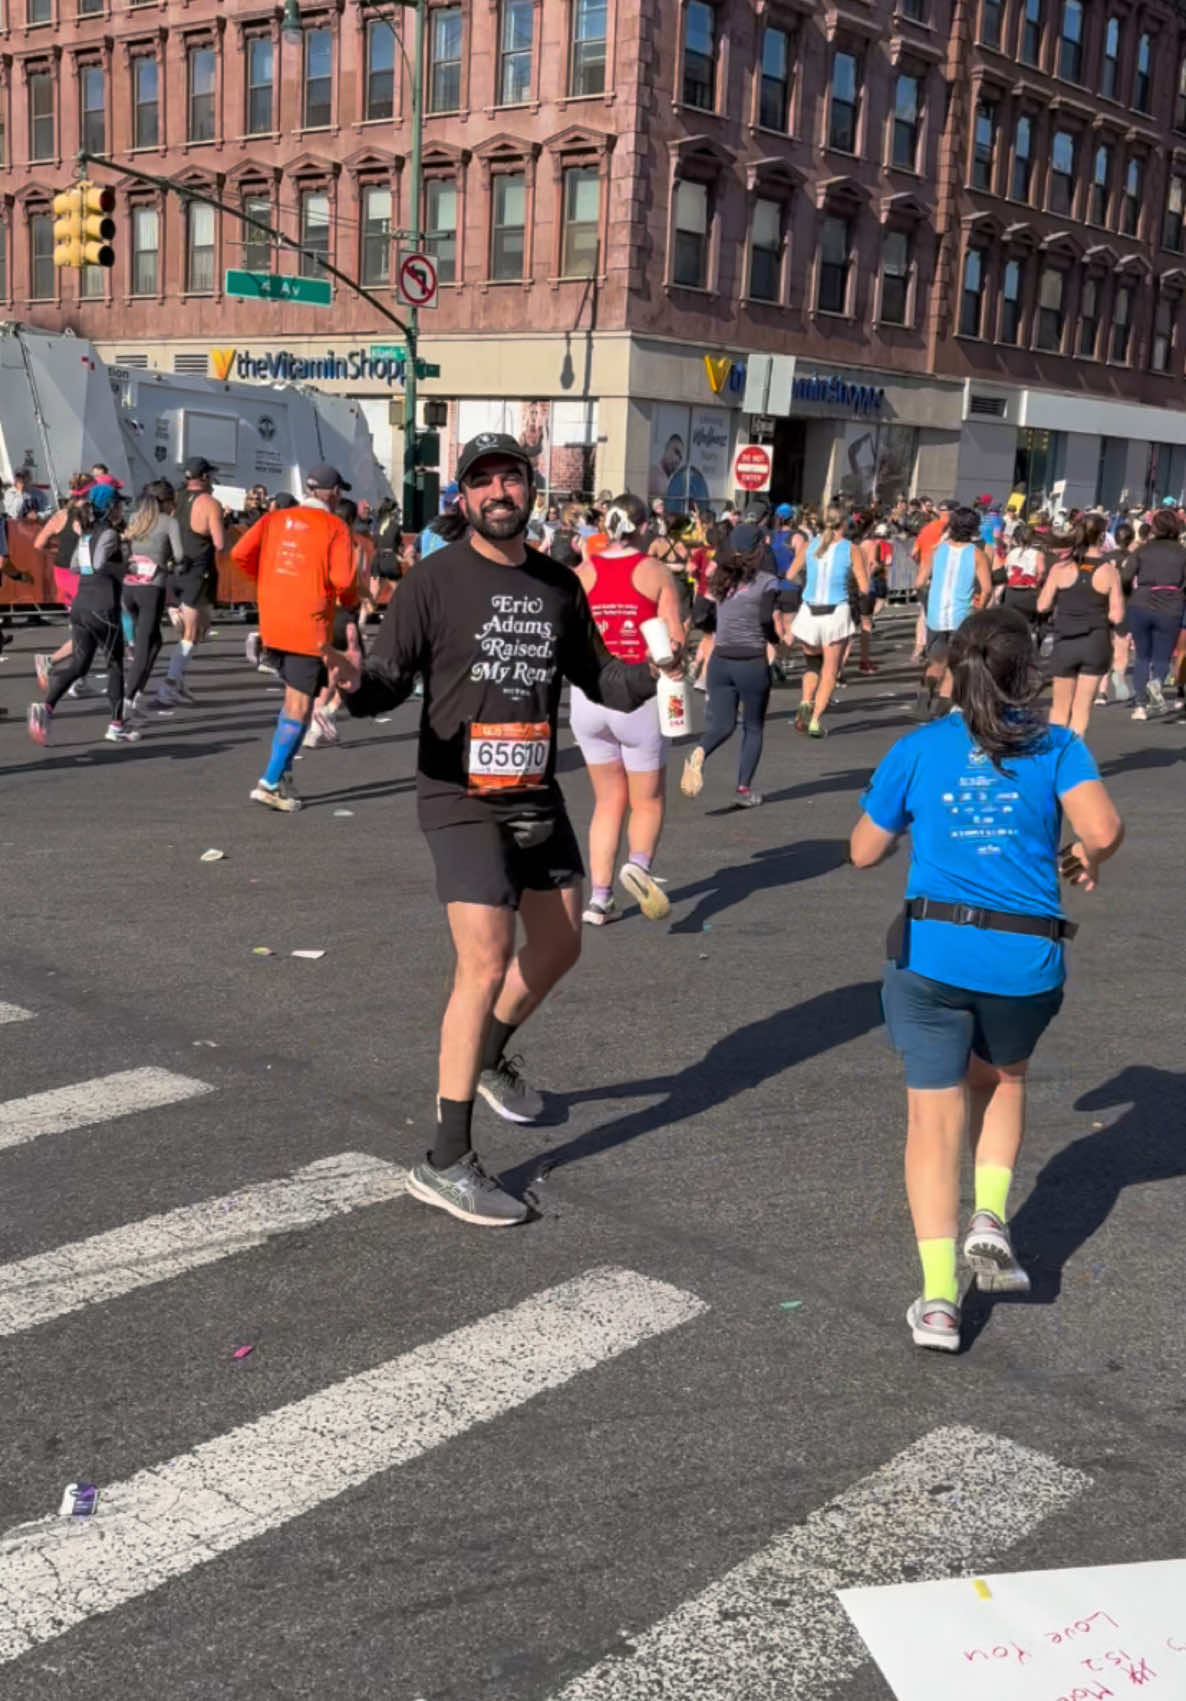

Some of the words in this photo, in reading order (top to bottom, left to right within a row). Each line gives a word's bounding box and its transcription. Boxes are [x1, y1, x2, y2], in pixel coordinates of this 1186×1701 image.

[280, 279, 301, 297] Av
[491, 594, 544, 614] Eric
[474, 614, 557, 642] Adams
[481, 638, 553, 661] Raised
[470, 661, 511, 684] My
[478, 742, 546, 767] 65610
